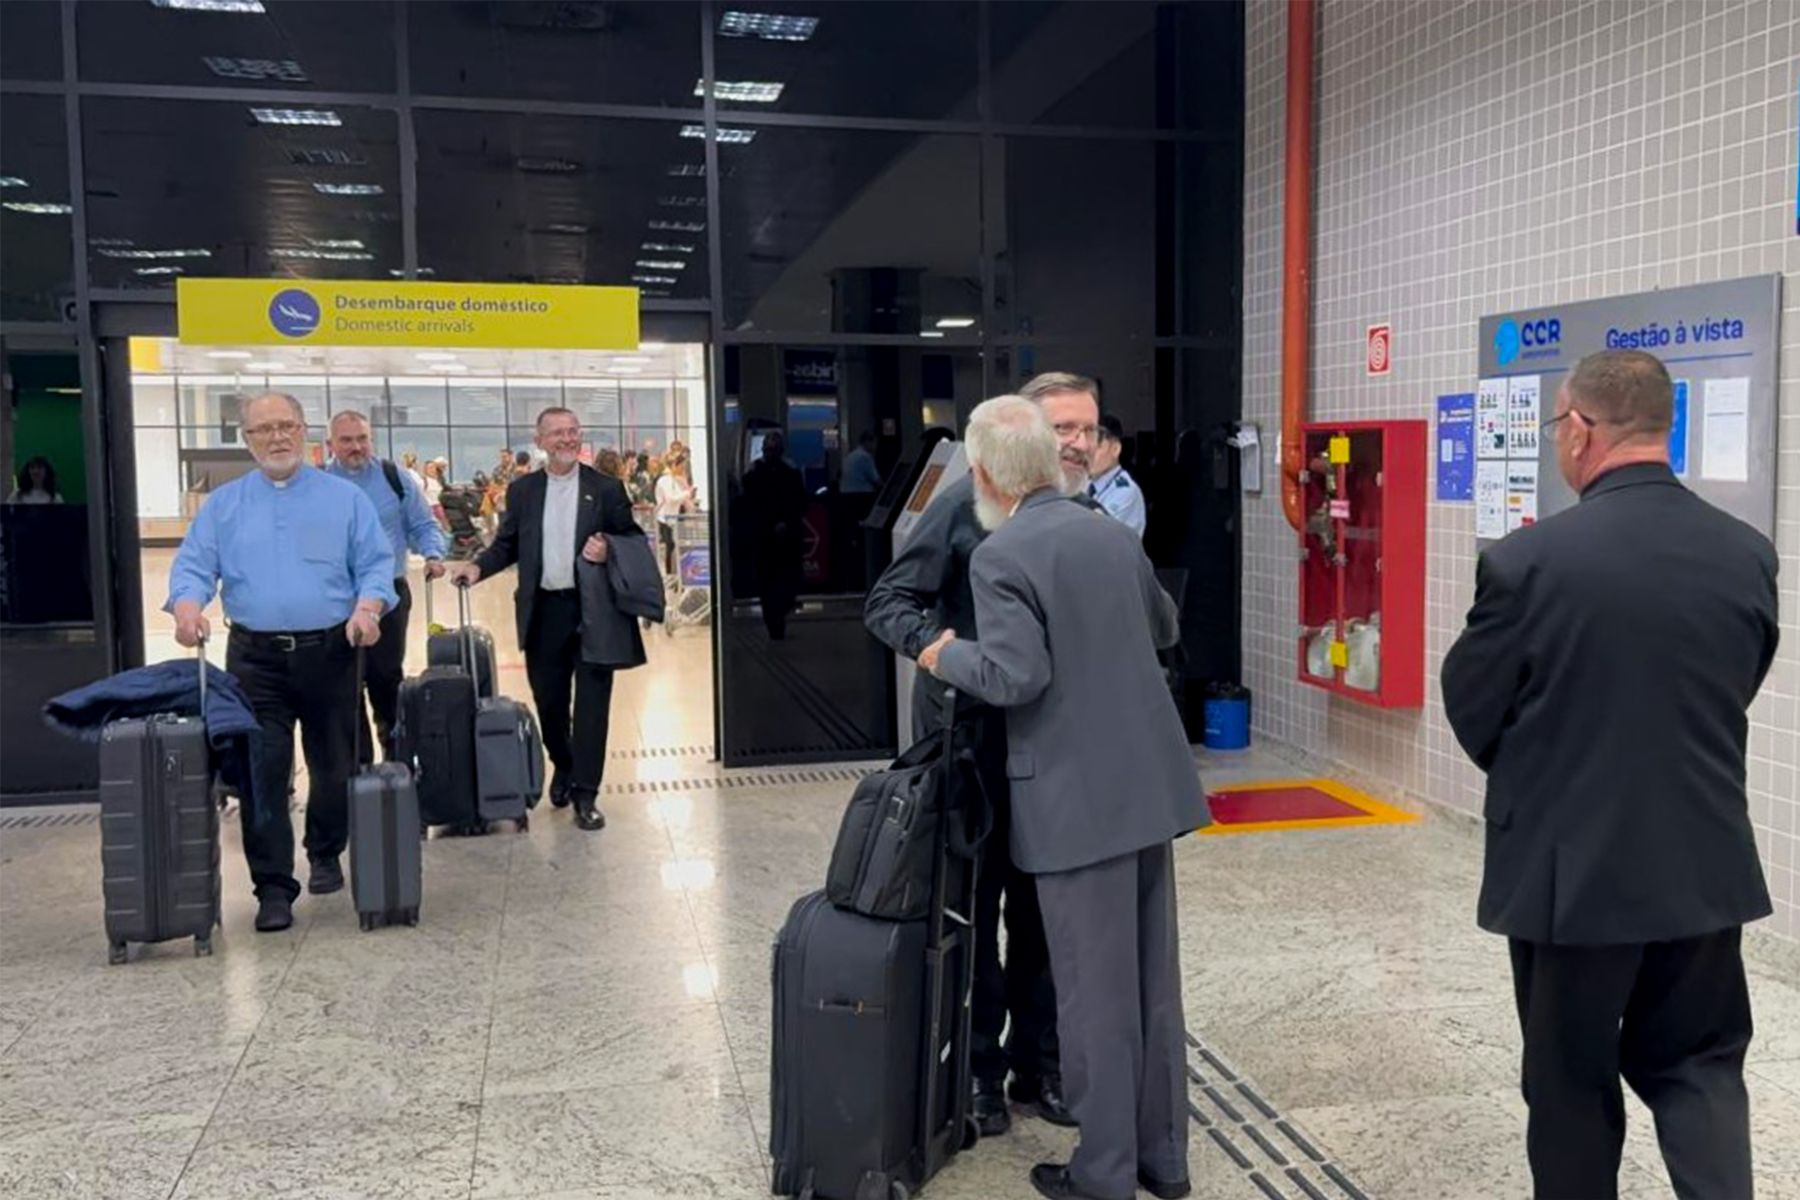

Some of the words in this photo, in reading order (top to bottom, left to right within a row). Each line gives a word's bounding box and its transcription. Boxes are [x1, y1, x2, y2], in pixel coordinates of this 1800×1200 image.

[335, 295, 456, 312] Desembarque
[461, 297, 548, 312] doméstico
[335, 317, 412, 332] Domestic
[417, 319, 476, 333] arrivals
[1522, 319, 1560, 346] CCR
[1606, 322, 1670, 348] Gestão
[1675, 320, 1686, 344] à
[1692, 317, 1743, 342] vista
